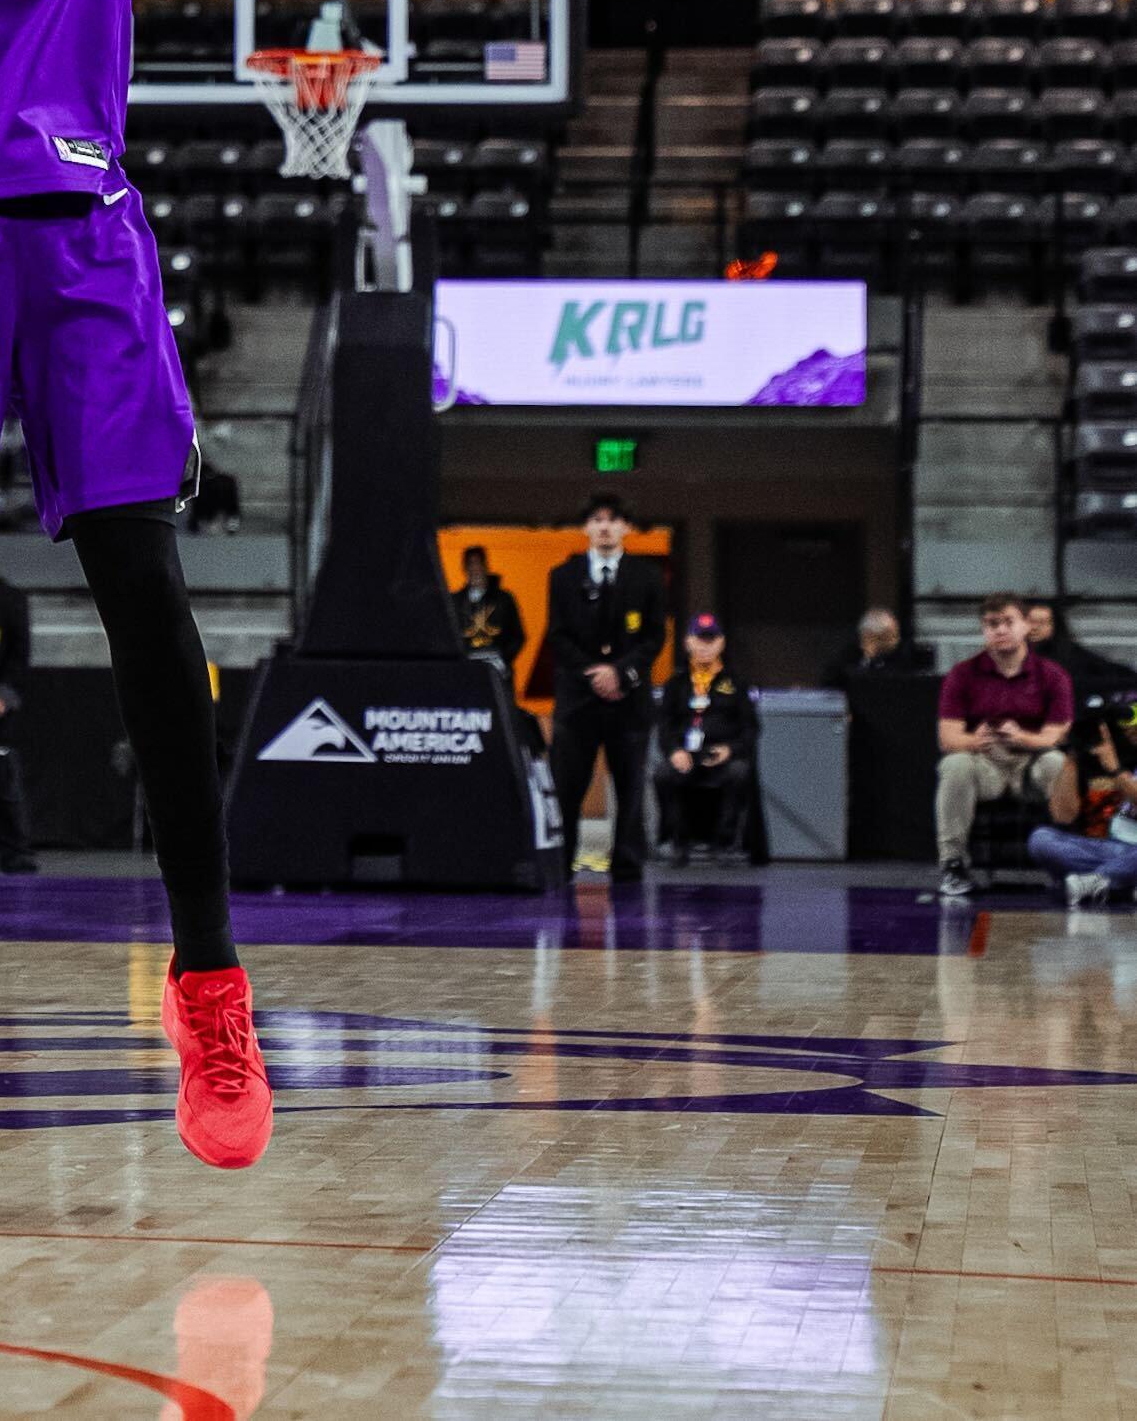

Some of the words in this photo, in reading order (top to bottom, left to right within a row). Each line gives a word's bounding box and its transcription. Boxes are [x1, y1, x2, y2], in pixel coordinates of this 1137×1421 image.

[548, 300, 706, 366] KRLG
[365, 709, 492, 732] MOUNTAIN
[373, 731, 484, 754] AMERICA
